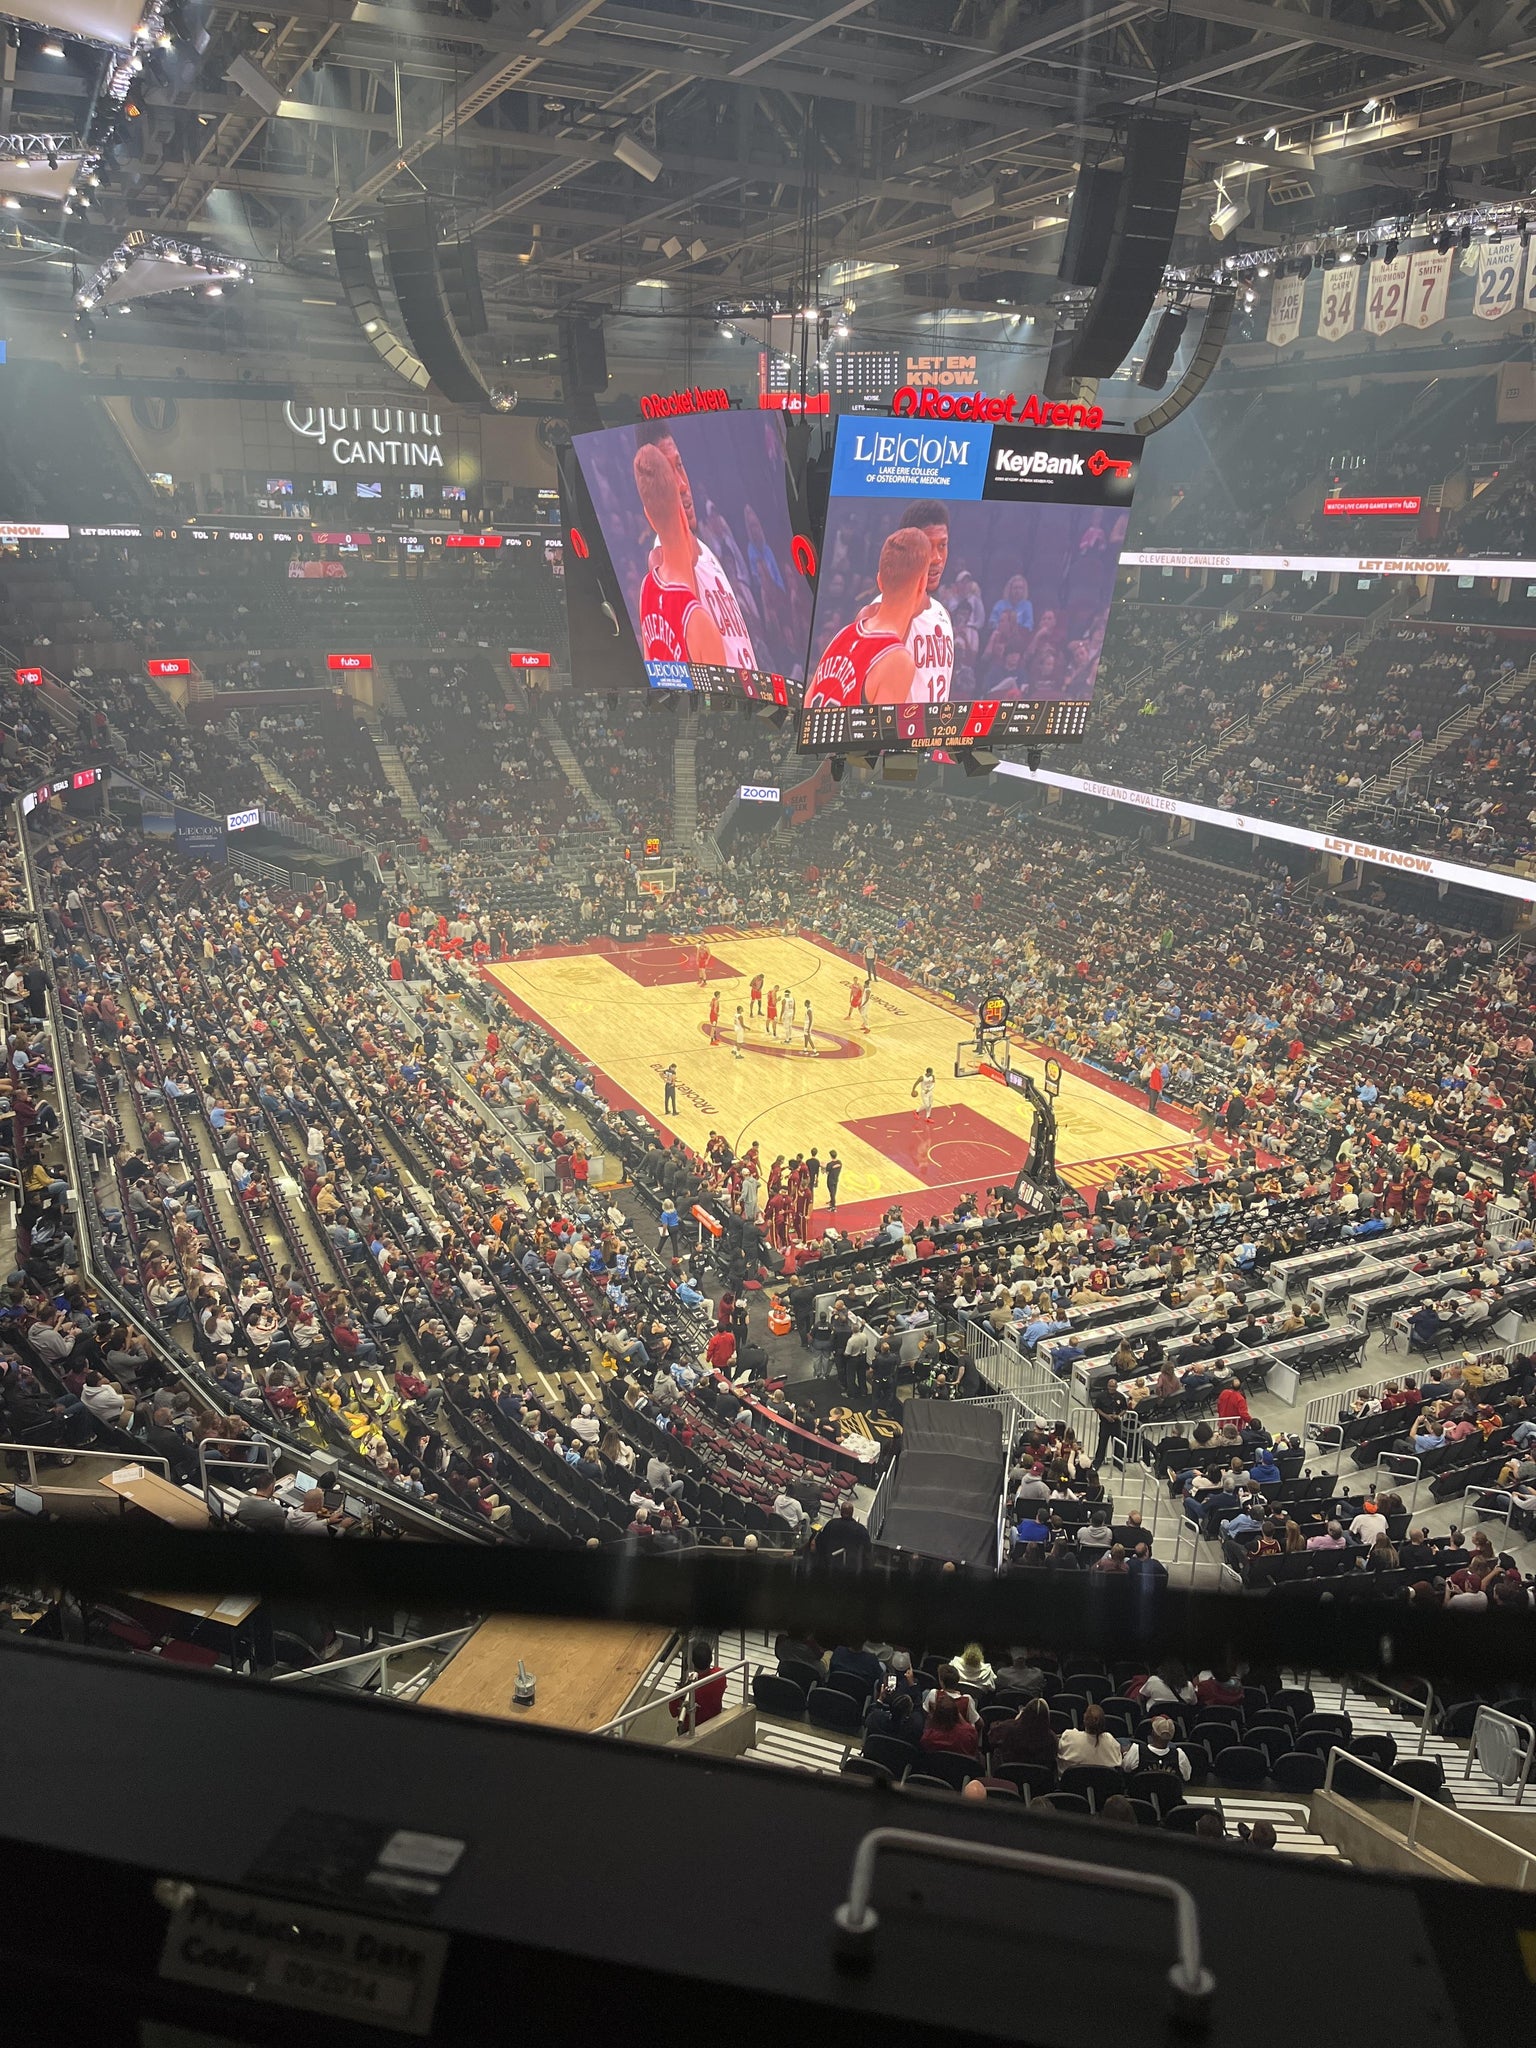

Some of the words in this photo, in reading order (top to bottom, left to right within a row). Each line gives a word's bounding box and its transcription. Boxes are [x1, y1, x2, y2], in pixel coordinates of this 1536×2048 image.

[1488, 243, 1515, 256] LARRY
[1486, 253, 1514, 266] NANCE
[1381, 262, 1398, 272] NATE
[1418, 265, 1442, 276] SMITH
[1330, 270, 1353, 282] AUSTIN
[1372, 272, 1406, 284] THURMOND
[1331, 281, 1350, 291] CARR
[1479, 266, 1515, 305] 22
[1282, 294, 1299, 308] JOE
[1369, 284, 1401, 319] 42
[1421, 278, 1436, 312] 7
[1280, 307, 1298, 320] TAIT
[1323, 292, 1352, 326] 34
[906, 356, 944, 370] LET
[947, 355, 977, 369] EM
[906, 371, 978, 385] KNOW.
[652, 388, 695, 418] Rocket
[694, 385, 730, 411] Arena
[919, 386, 1018, 423] Rocket
[1018, 394, 1104, 430] Arena
[333, 438, 444, 467] CANTINA
[995, 449, 1085, 476] KeyBank
[879, 466, 896, 474] LAKE
[896, 467, 910, 475] ERIE
[911, 468, 939, 476] COLLEGE
[866, 474, 876, 482] OF
[876, 475, 918, 484] OSTEOPATHIC
[920, 476, 950, 485] MEDICINE
[1403, 500, 1418, 509] fubo
[80, 528, 96, 536] LET
[99, 528, 110, 536] EM
[110, 529, 142, 537] KNOW.
[171, 530, 177, 539] 0
[192, 532, 208, 540] TOL
[212, 532, 219, 540] 7
[229, 532, 253, 540] FOULS
[257, 533, 263, 541] 0
[297, 534, 303, 542] 0
[345, 535, 352, 543] 0
[399, 536, 418, 544] 12:00
[429, 536, 442, 545] 1Q
[525, 539, 532, 547] 0
[1138, 555, 1187, 564] CLEVELAND
[1188, 556, 1231, 566] CAVALIERS
[1358, 560, 1382, 570] LET
[1384, 561, 1404, 571] EM
[1404, 561, 1450, 572] KNOW.
[642, 613, 682, 661] HUERTER
[914, 634, 953, 668] CAVS
[160, 662, 179, 672] fubo
[341, 658, 360, 667] fubo
[521, 656, 540, 665] fubo
[816, 655, 857, 699] HUERTER
[747, 685, 753, 696] 0
[927, 675, 946, 702] 12
[928, 706, 939, 714] 1Q
[958, 705, 968, 714] 24
[1001, 711, 1007, 720] 0
[886, 715, 892, 724] 0
[907, 723, 916, 736] 0
[932, 725, 957, 736] 12:00
[974, 722, 982, 733] 0
[911, 737, 943, 747] CLEVELAND
[945, 737, 974, 746] CAVALIERS
[53, 781, 68, 792] STEALS
[743, 788, 779, 799] zoom
[229, 812, 258, 827] zoom
[1083, 782, 1128, 800] CLEVELAND
[1129, 793, 1176, 812] CAVALIERS
[1324, 837, 1354, 853] LET
[1353, 845, 1377, 859] EM
[1379, 852, 1434, 874] KNOW.
[646, 844, 659, 854] 24
[985, 1008, 1002, 1022] 24
[354, 1934, 425, 1971] Date
